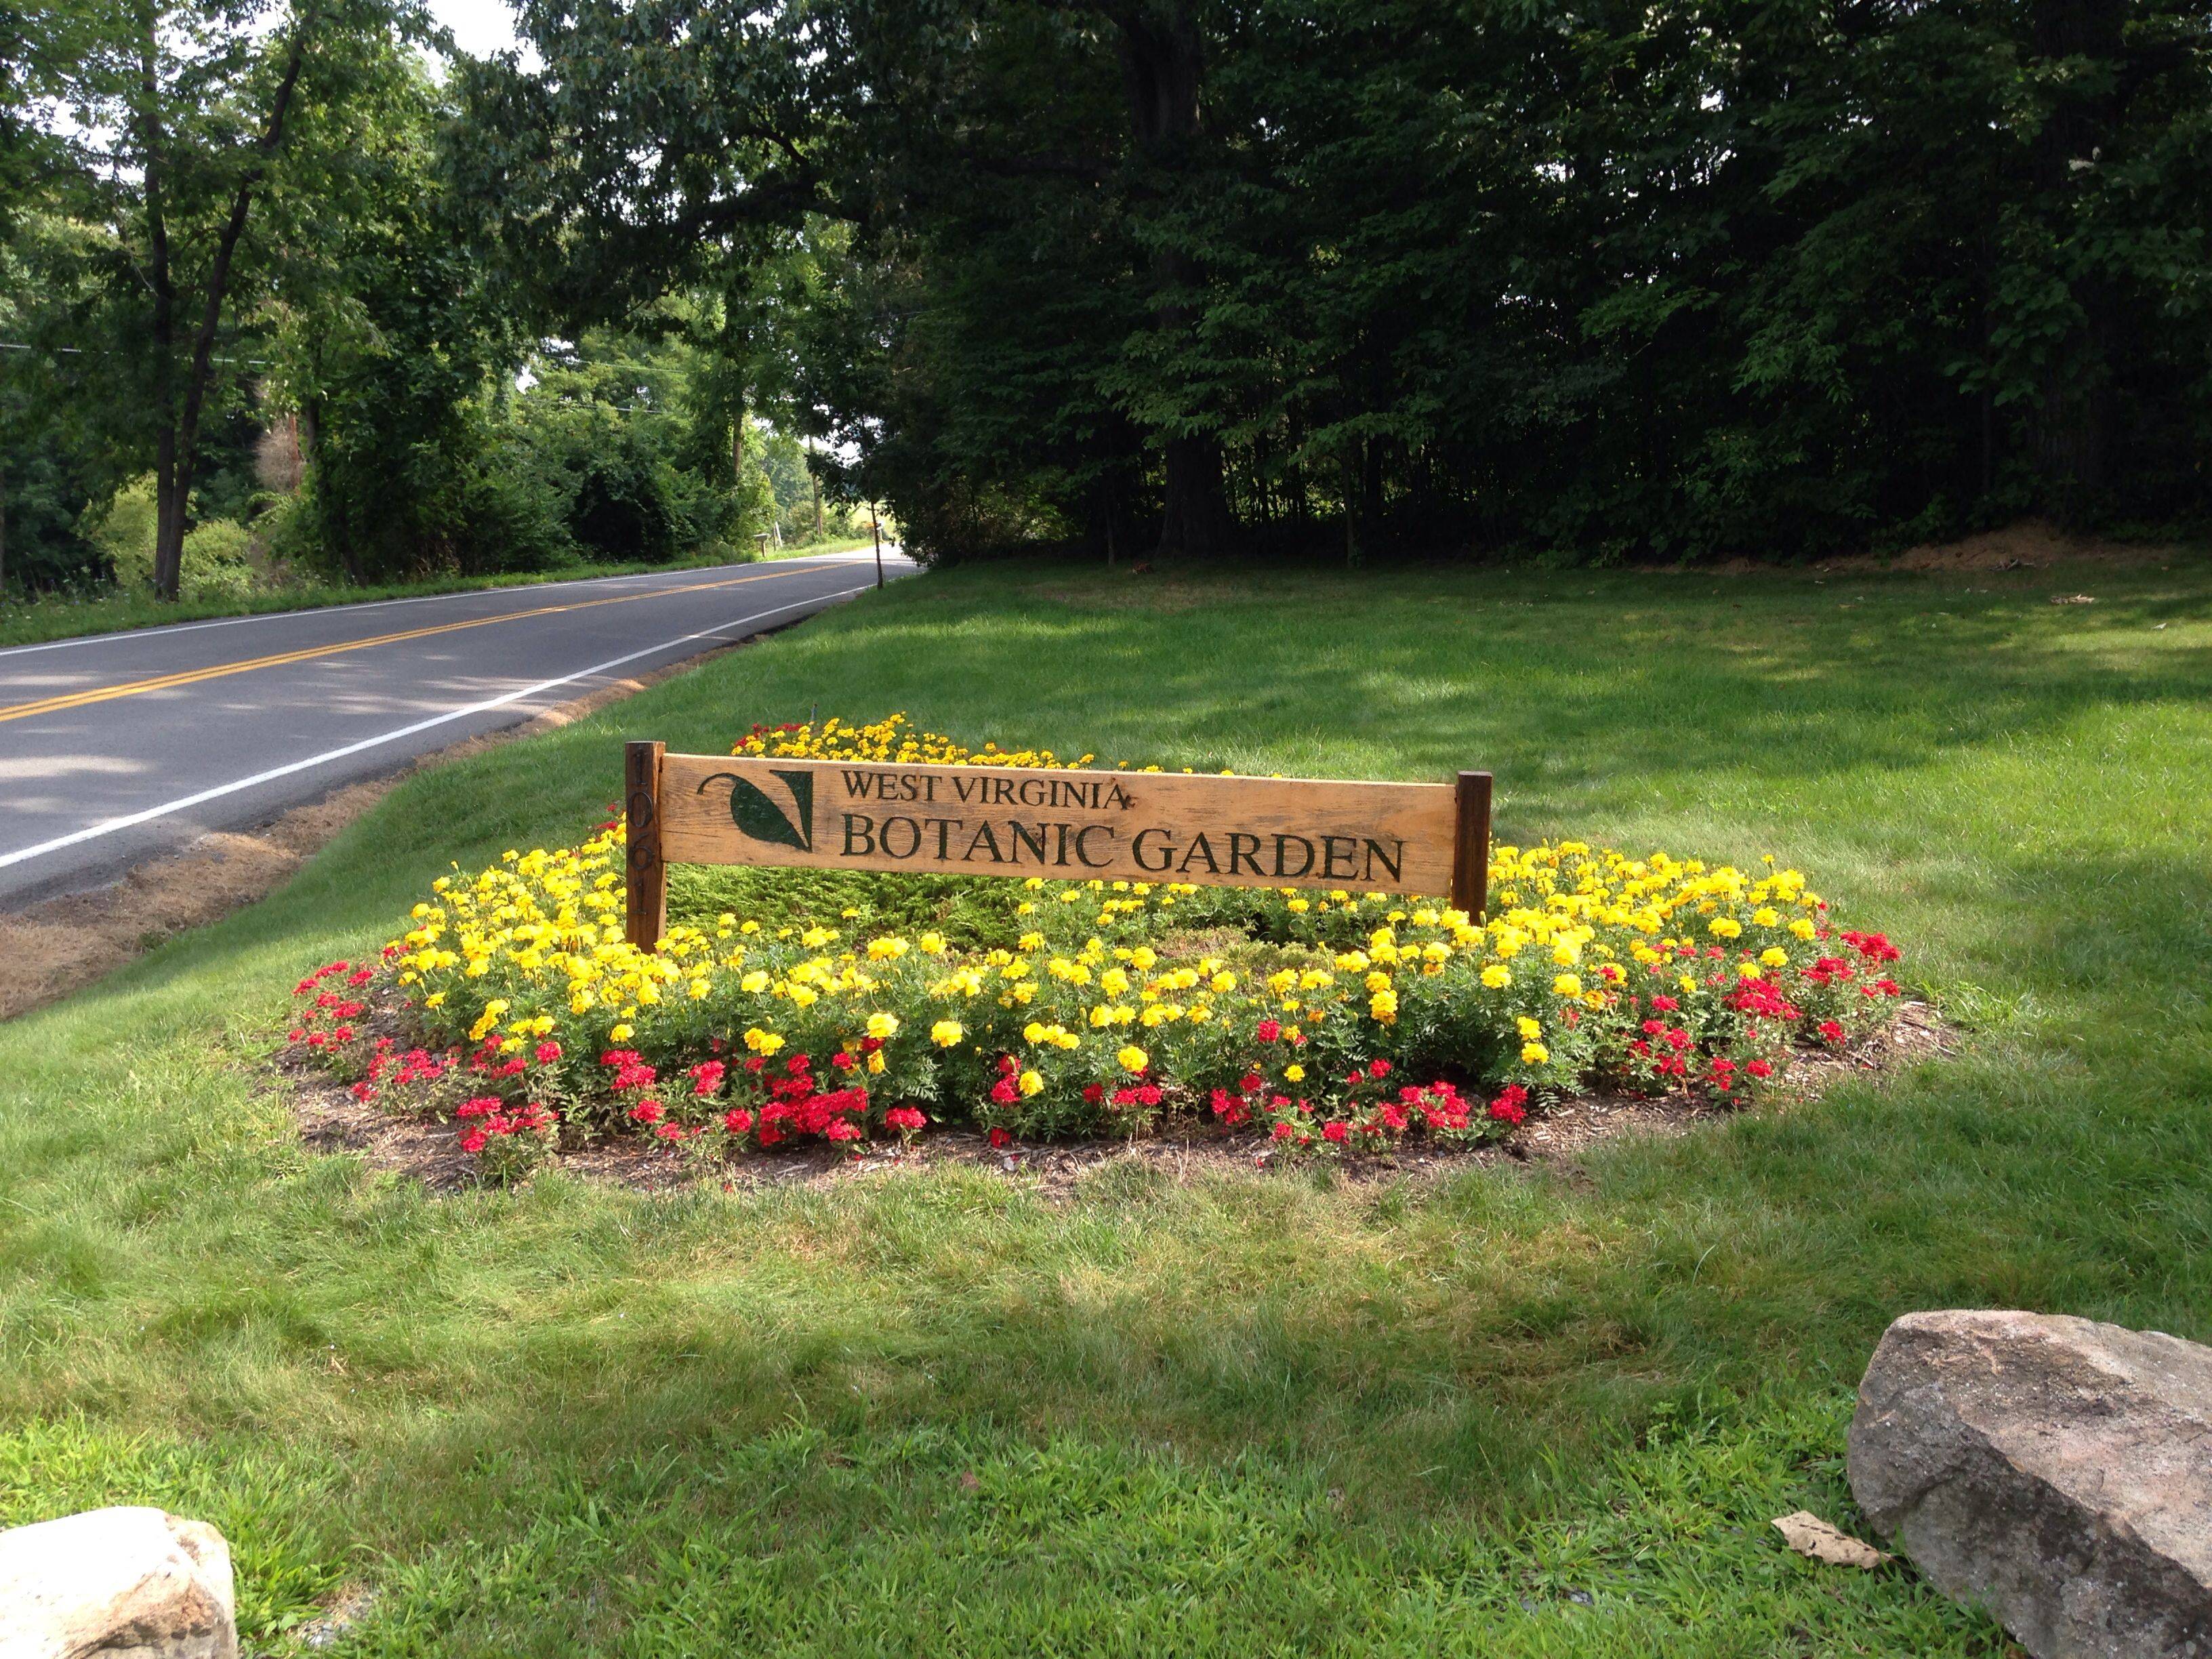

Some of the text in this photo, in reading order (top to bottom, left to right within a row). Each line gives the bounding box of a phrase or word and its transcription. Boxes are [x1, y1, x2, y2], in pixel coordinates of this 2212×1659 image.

[840, 770, 1130, 811] WEST VIRGINIA
[840, 813, 1408, 883] BOTANIC GARDEN
